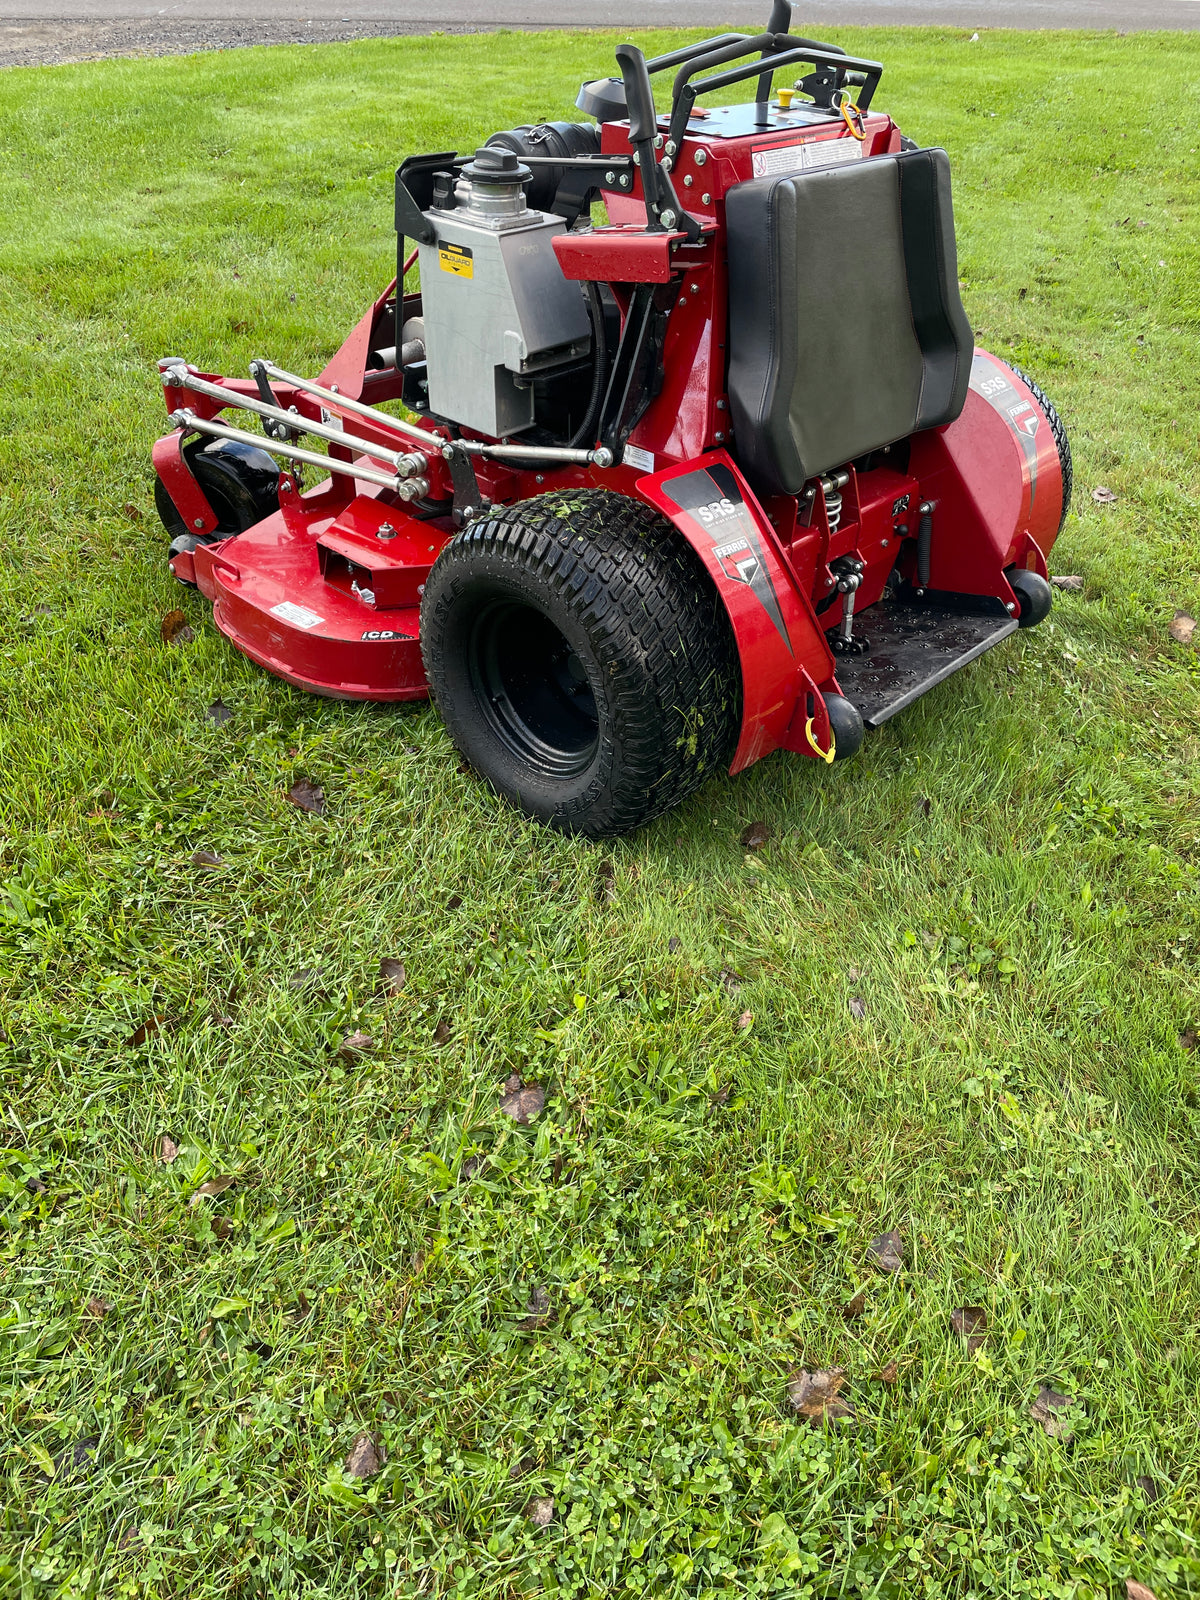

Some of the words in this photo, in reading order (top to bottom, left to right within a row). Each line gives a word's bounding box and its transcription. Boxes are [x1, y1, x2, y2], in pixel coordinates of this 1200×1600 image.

[980, 376, 1007, 395] SRS
[697, 498, 736, 522] SRS
[715, 539, 748, 558] FERRIS
